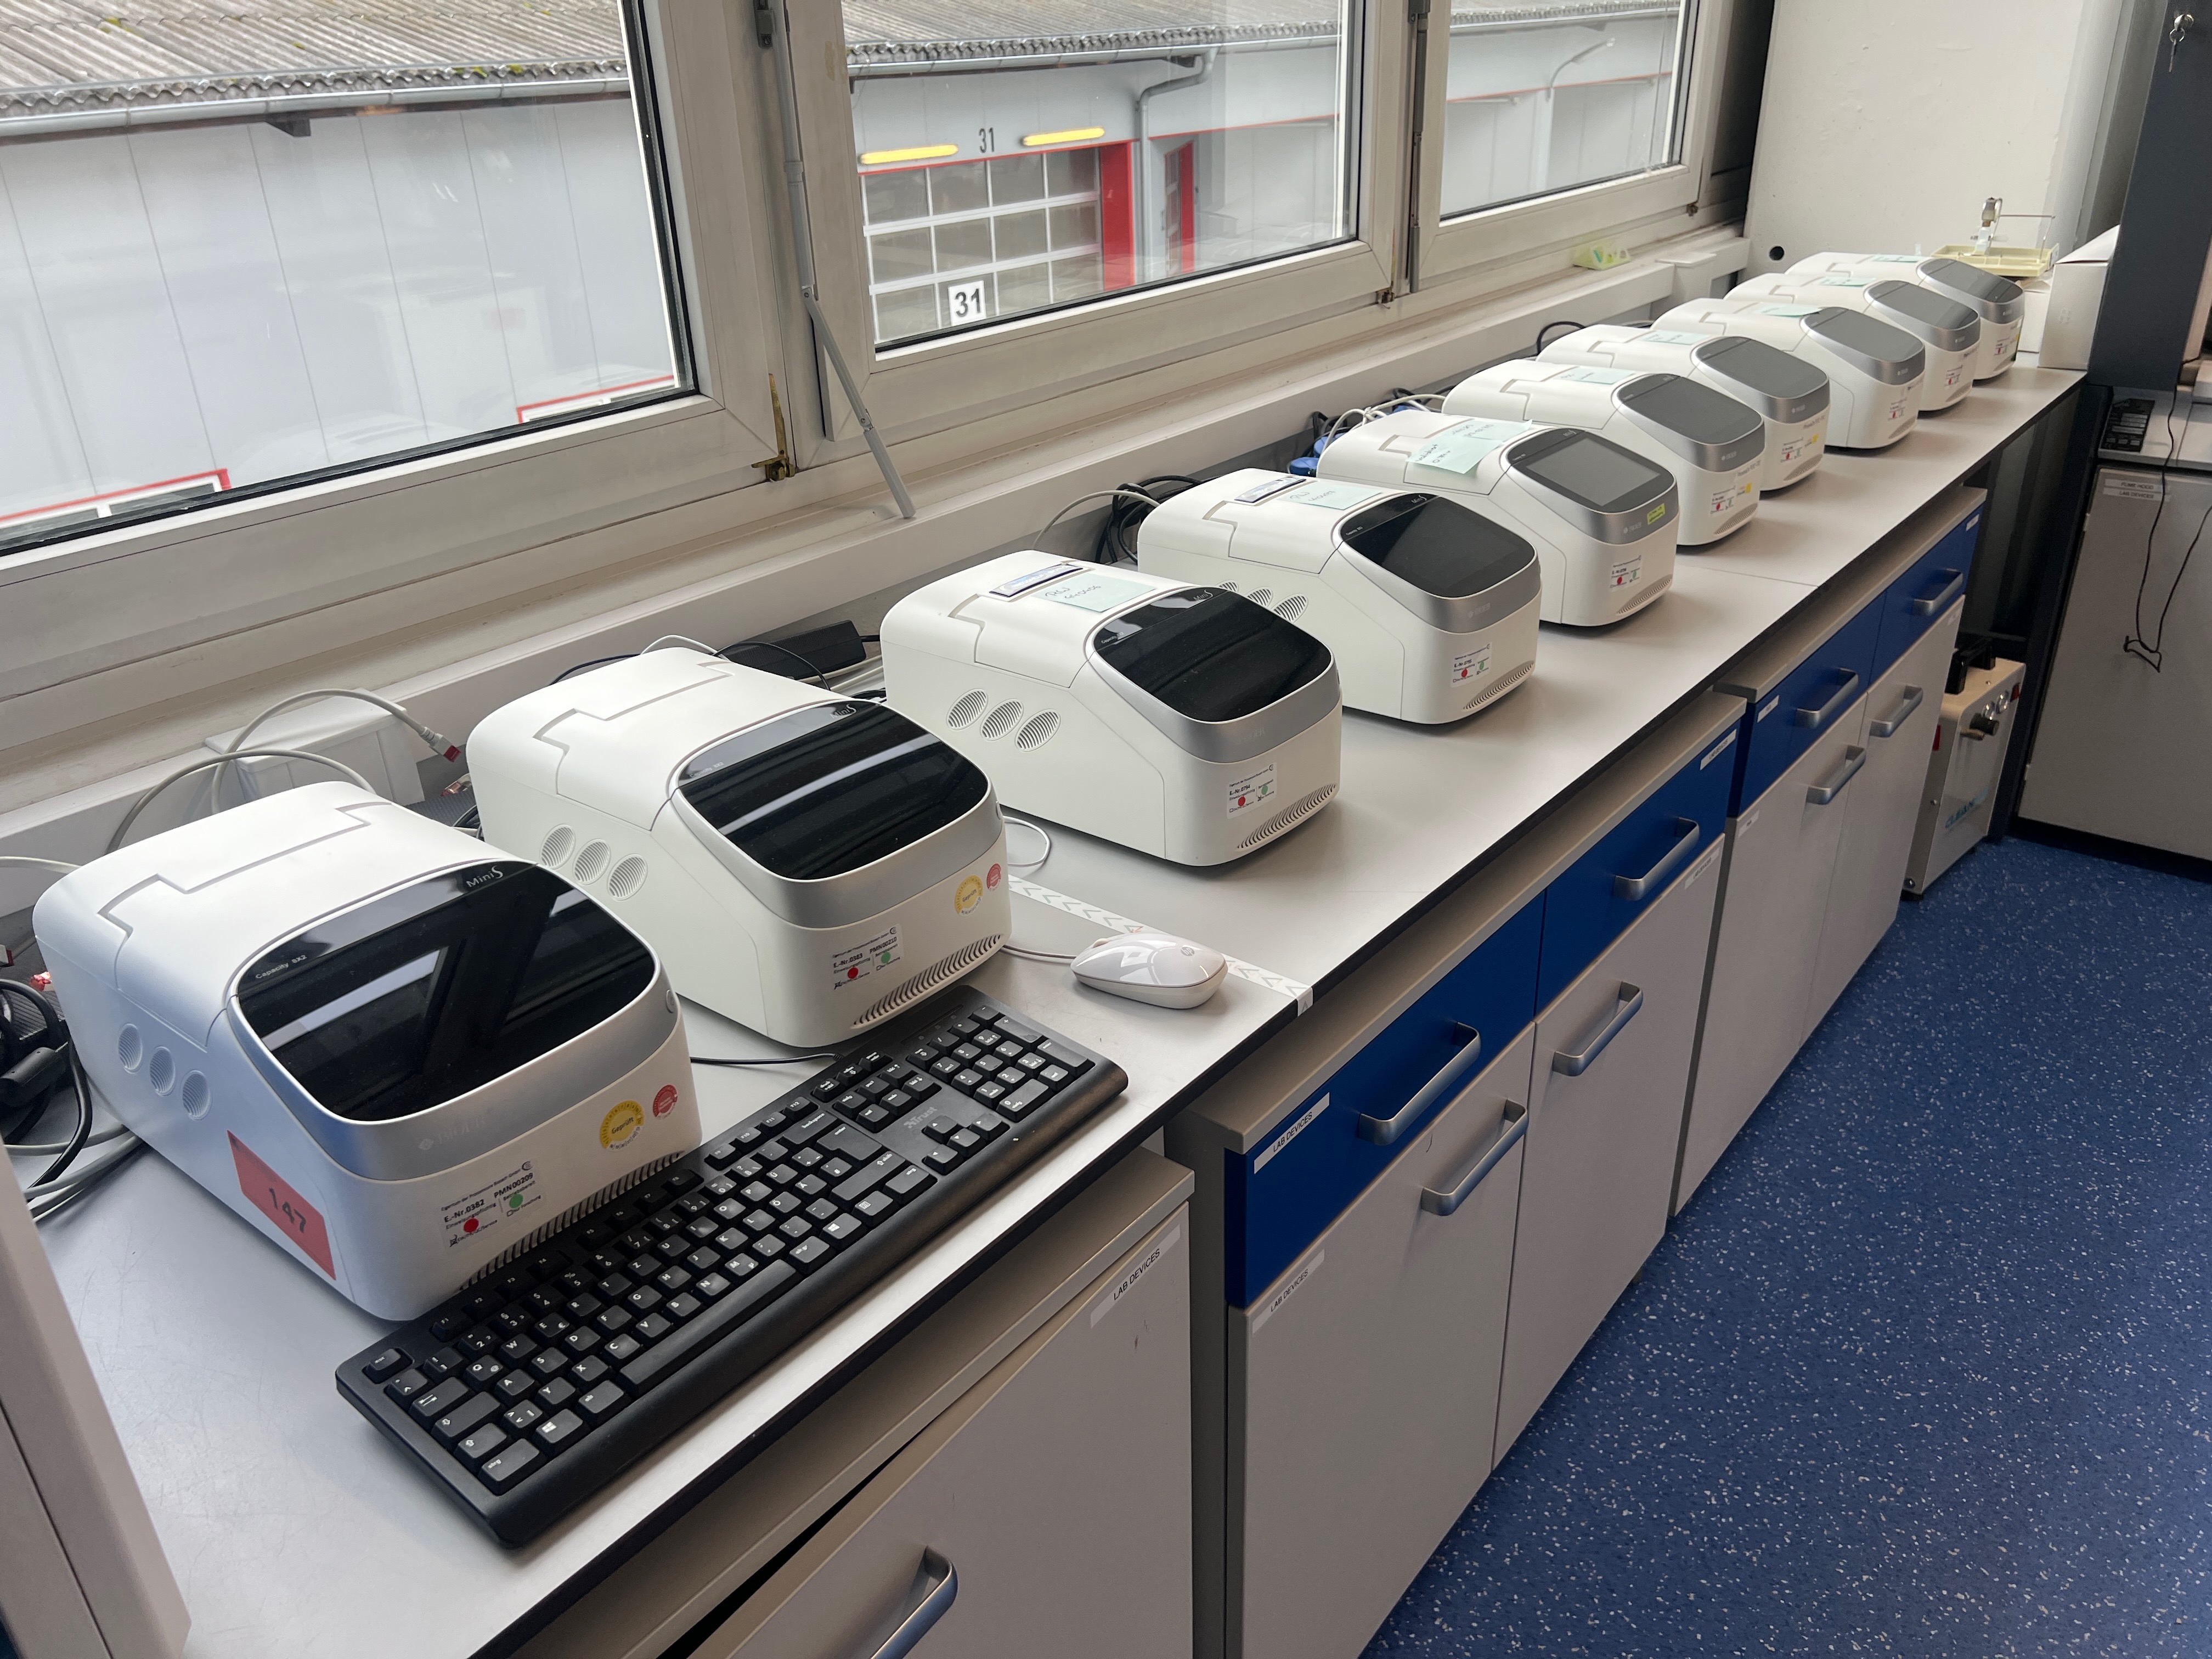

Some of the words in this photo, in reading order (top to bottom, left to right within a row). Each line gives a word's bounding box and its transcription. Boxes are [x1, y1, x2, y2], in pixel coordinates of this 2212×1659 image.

[979, 127, 995, 153] 31
[954, 288, 981, 318] 31
[830, 703, 857, 719] MiniS
[466, 865, 504, 887] MiniS
[255, 962, 289, 979] Capacity
[611, 1116, 635, 1134] Geprüft
[910, 1107, 938, 1123] Trust
[1273, 1136, 1285, 1152] LAB
[1286, 1111, 1312, 1141] DEVICES
[268, 1187, 306, 1233] 147
[444, 1199, 485, 1223] E.-Nr.0382
[494, 1172, 533, 1198] PMN00209
[1114, 1280, 1128, 1301] LAB
[1129, 1248, 1160, 1284] DEVICES
[1271, 1295, 1282, 1312] LAB
[1284, 1268, 1308, 1299] DEVICES
